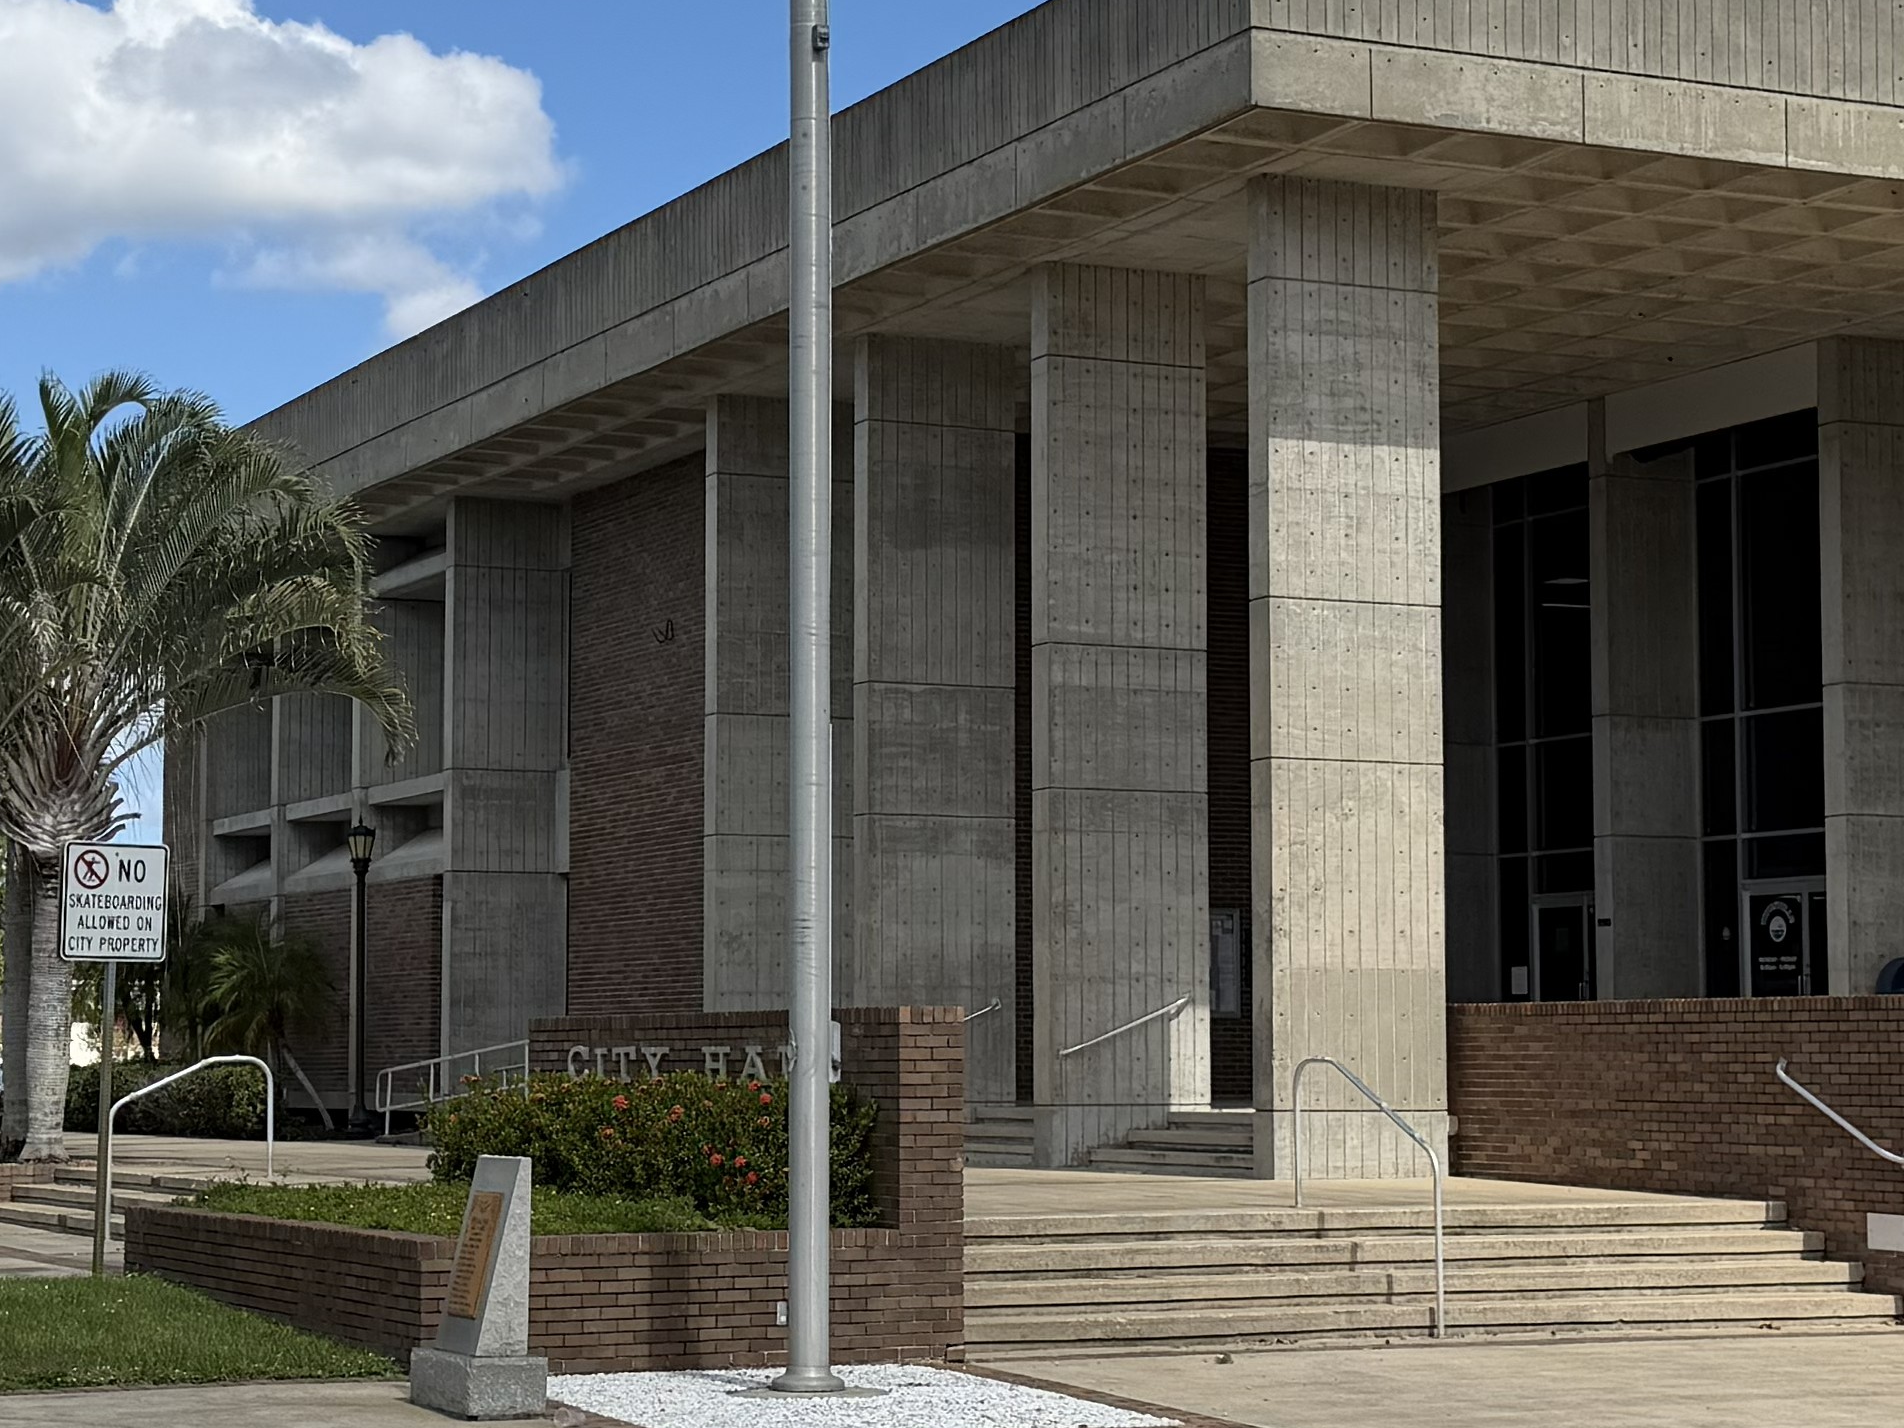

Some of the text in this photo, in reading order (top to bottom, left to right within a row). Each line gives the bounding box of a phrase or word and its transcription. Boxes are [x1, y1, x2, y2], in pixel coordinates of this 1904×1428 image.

[118, 859, 146, 883] NO
[69, 893, 162, 911] SKATEBOARDING
[77, 915, 152, 931] ALLOWED ON
[68, 936, 159, 952] CITY PROPERTY
[567, 1045, 670, 1082] CITY
